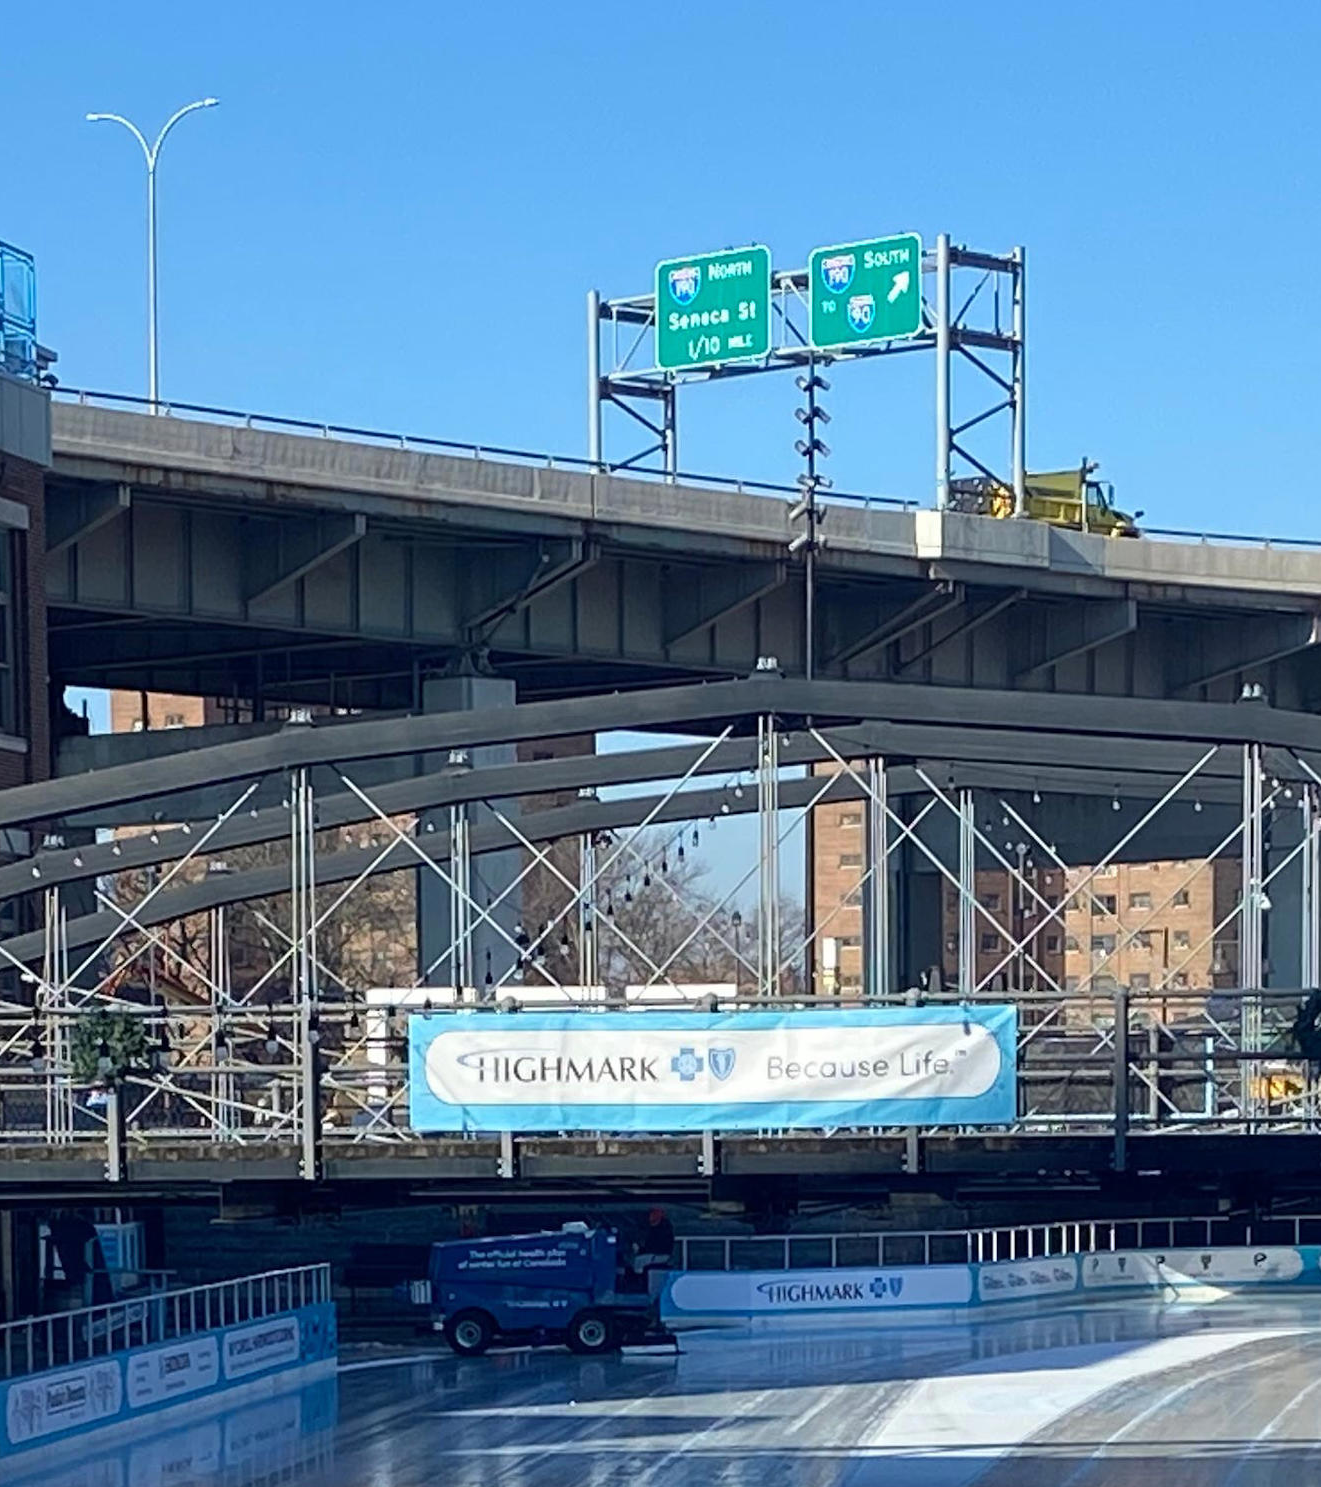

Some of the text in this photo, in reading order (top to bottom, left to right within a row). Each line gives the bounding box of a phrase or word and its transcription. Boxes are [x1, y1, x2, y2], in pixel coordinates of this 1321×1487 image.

[864, 248, 909, 268] SOUTH
[708, 261, 752, 281] NORTH
[669, 300, 756, 331] Seneca St
[821, 300, 836, 313] TO
[850, 304, 871, 324] 90
[689, 333, 754, 360] 1/10 MILE
[457, 1049, 660, 1083] HIGHMARK
[767, 1056, 889, 1080] Because
[757, 1280, 865, 1303] HIGHMARK
